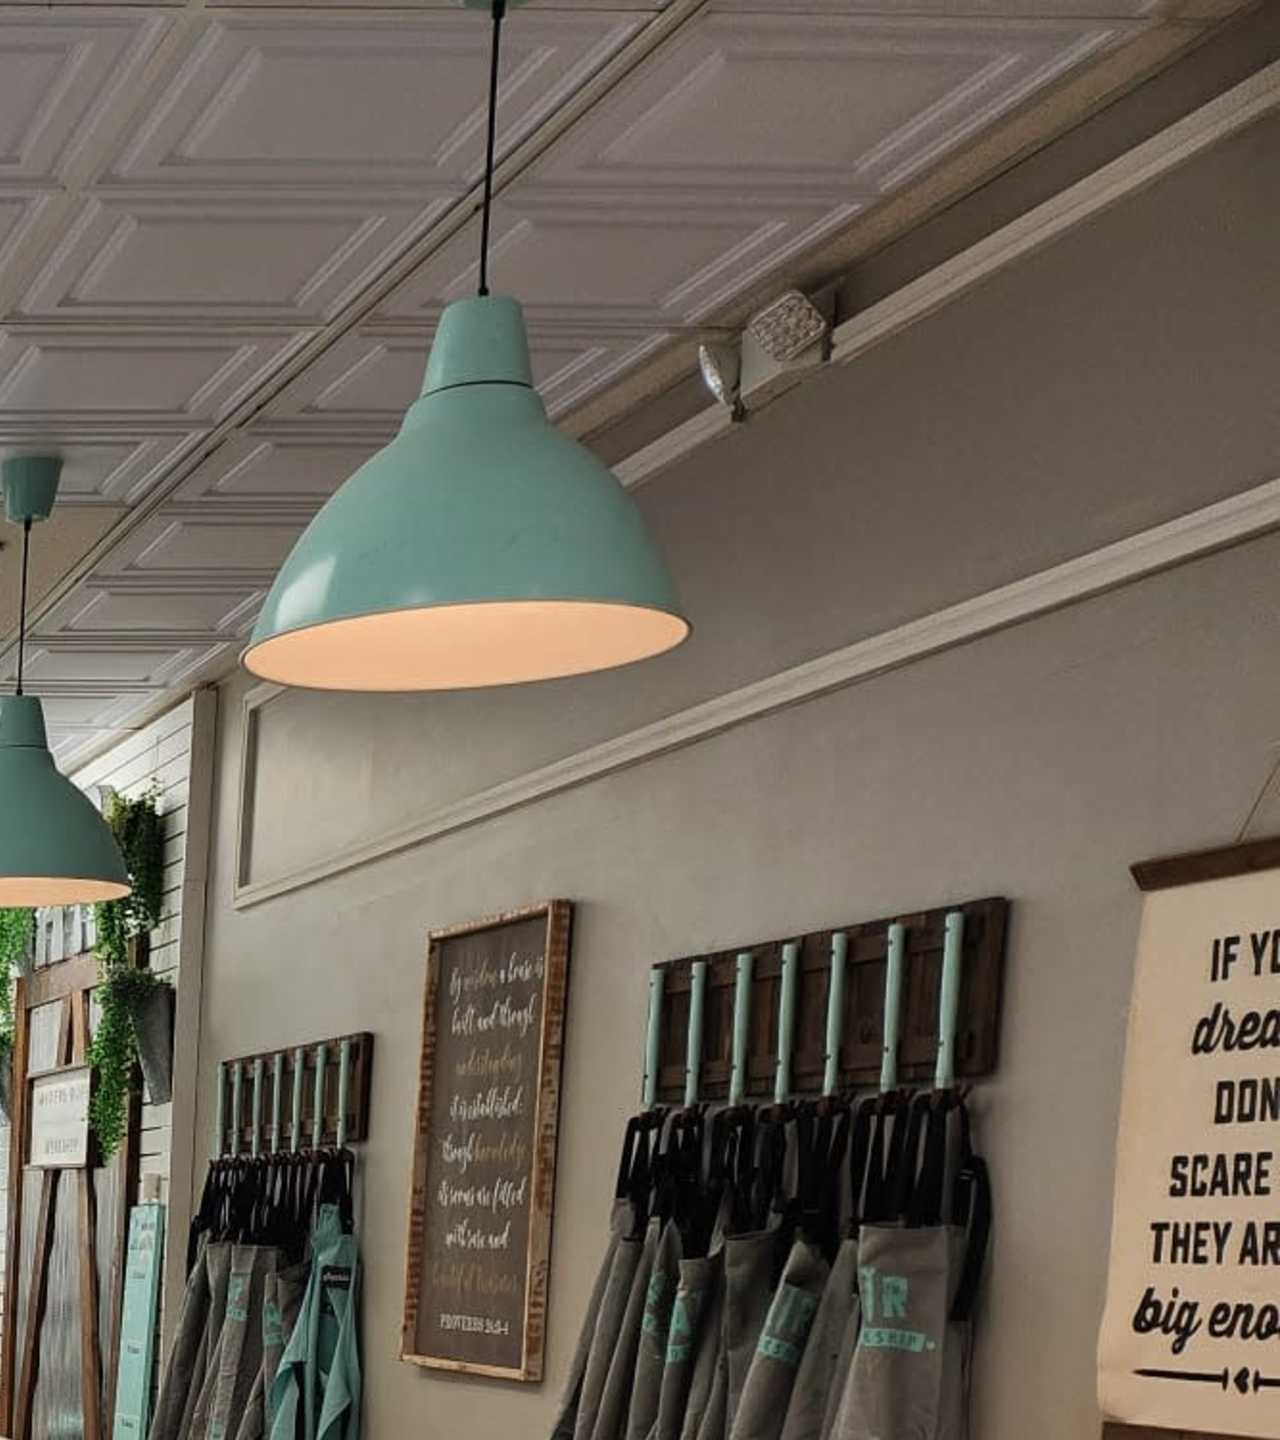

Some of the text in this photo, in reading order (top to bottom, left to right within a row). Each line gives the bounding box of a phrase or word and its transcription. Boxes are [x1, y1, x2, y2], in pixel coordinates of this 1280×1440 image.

[1211, 936, 1240, 982] IF
[1169, 1151, 1273, 1197] SCARE
[1151, 1221, 1233, 1265] THEY
[1133, 1286, 1203, 1355] big
